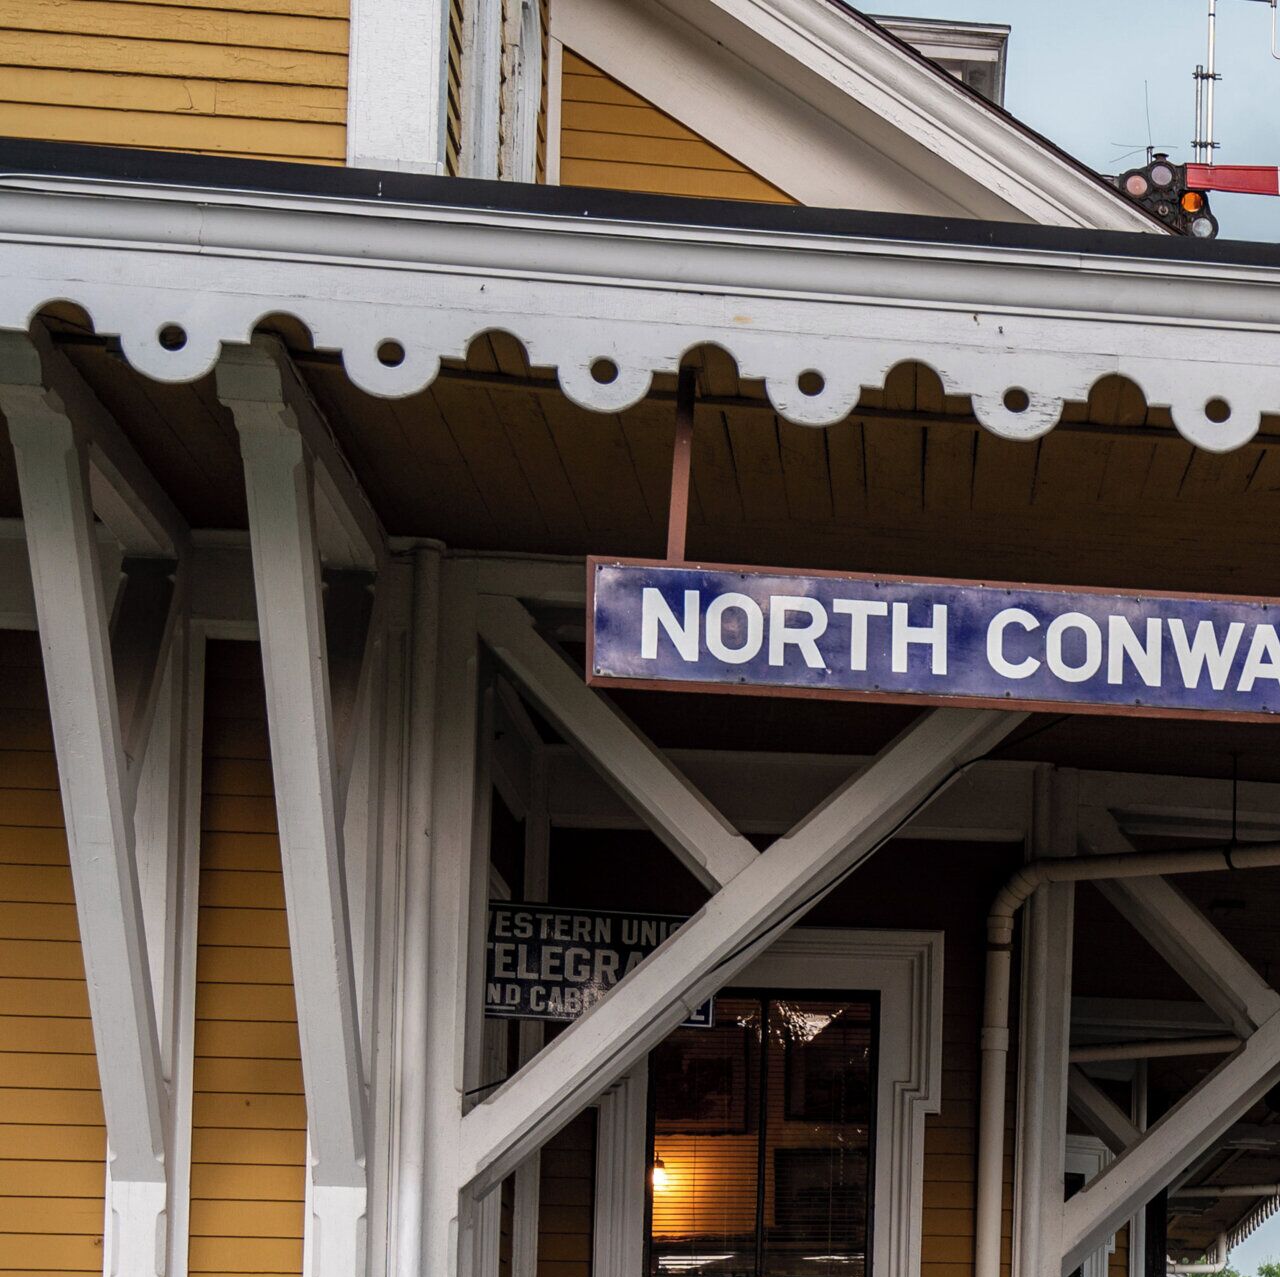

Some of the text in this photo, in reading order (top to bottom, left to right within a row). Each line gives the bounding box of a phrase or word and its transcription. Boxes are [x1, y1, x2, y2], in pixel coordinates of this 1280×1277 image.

[640, 587, 948, 676] NORTH
[488, 911, 686, 947] ESTERN UNI
[486, 941, 645, 983] ELEGRA
[486, 982, 608, 1013] ND CAB
